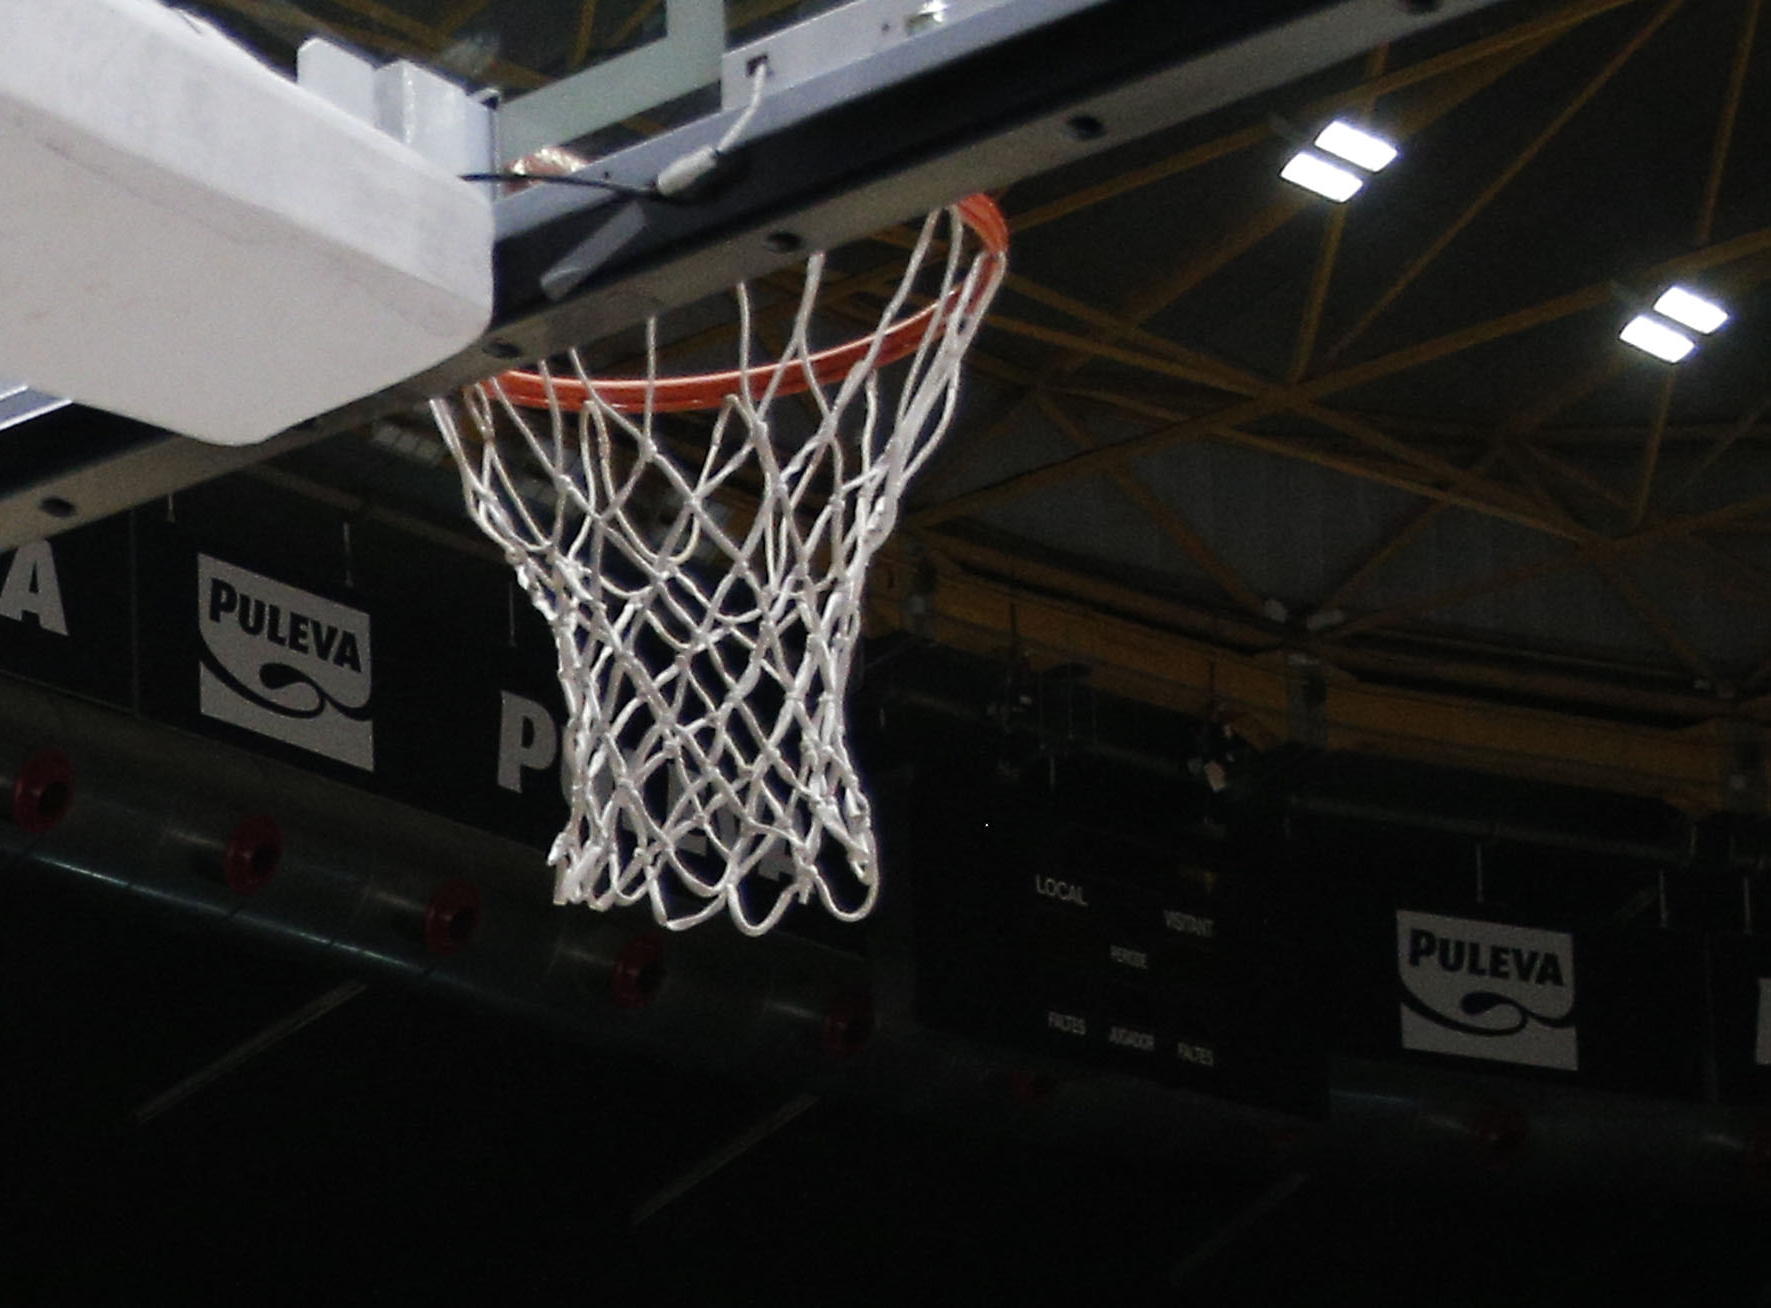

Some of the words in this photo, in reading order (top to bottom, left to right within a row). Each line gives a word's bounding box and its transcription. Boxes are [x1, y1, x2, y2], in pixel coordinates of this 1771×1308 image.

[209, 577, 362, 674] PULEVA
[1036, 873, 1089, 907] LOCAL
[1408, 927, 1565, 988] PULEVA
